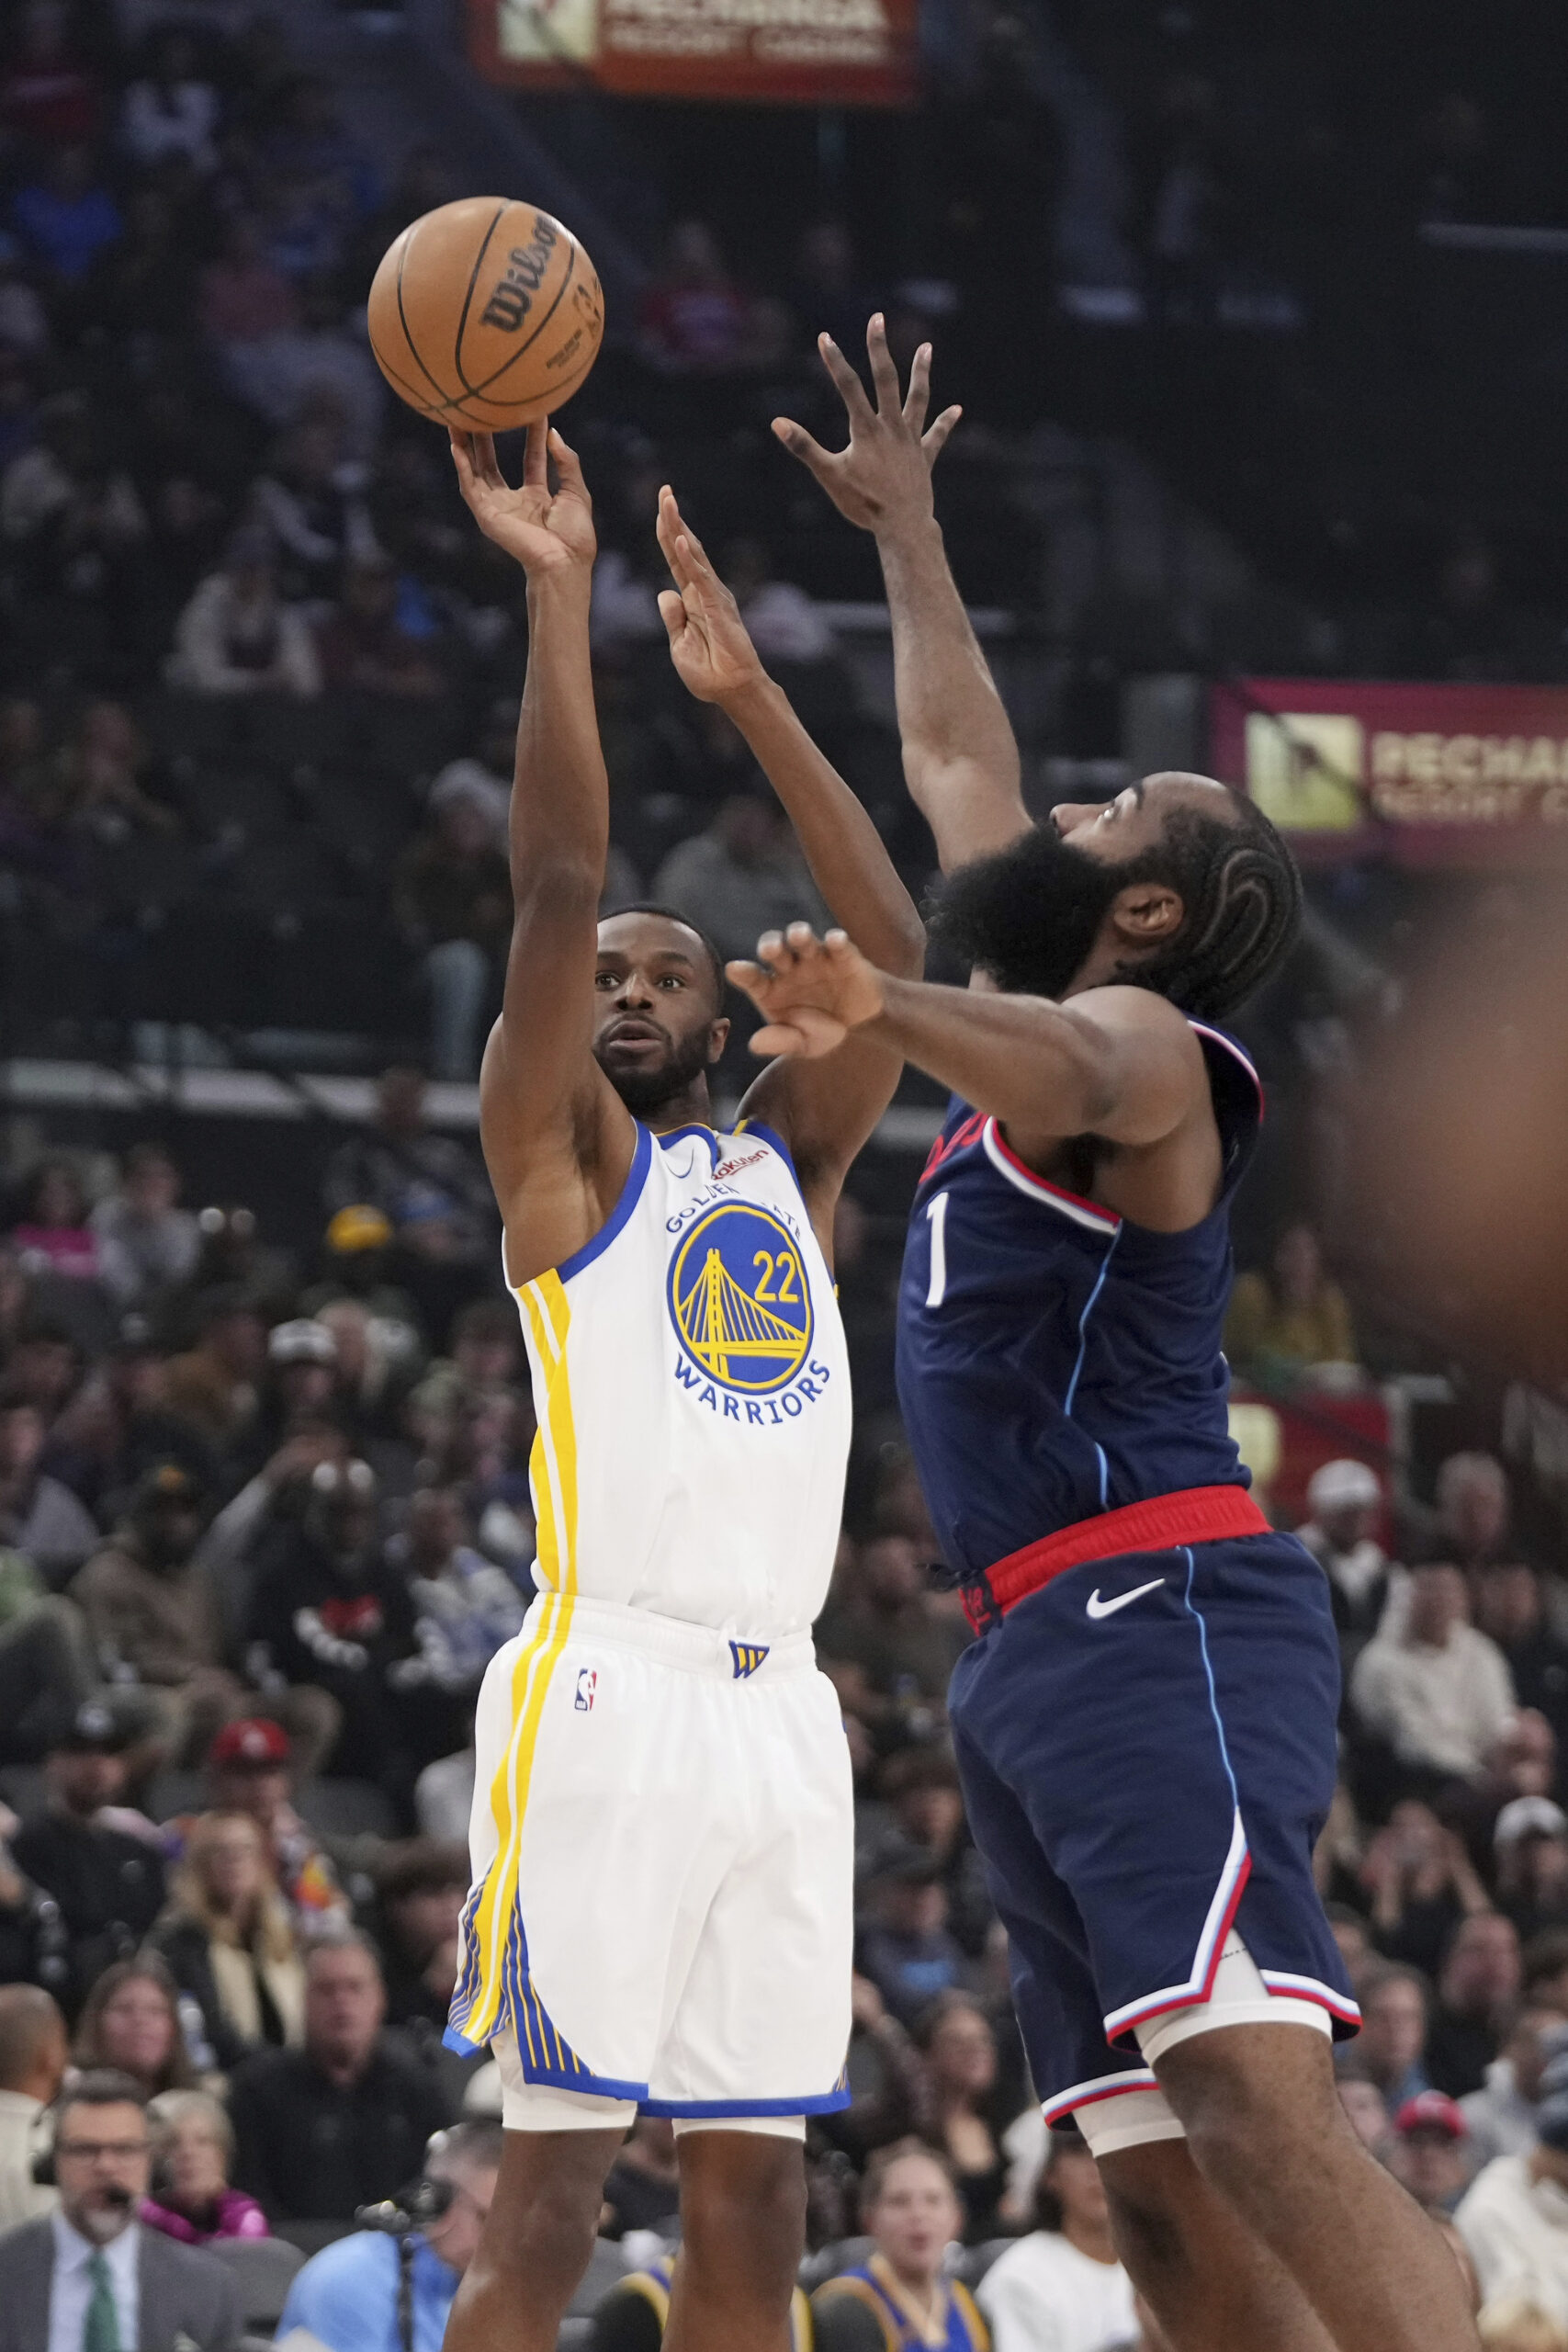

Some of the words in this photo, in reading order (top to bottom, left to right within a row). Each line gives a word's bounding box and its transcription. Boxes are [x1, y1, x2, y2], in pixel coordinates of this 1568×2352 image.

[1372, 731, 1568, 783] PECHA
[752, 1250, 800, 1304] 22
[925, 1192, 950, 1308] 1
[674, 1351, 830, 1425] WARRIORS
